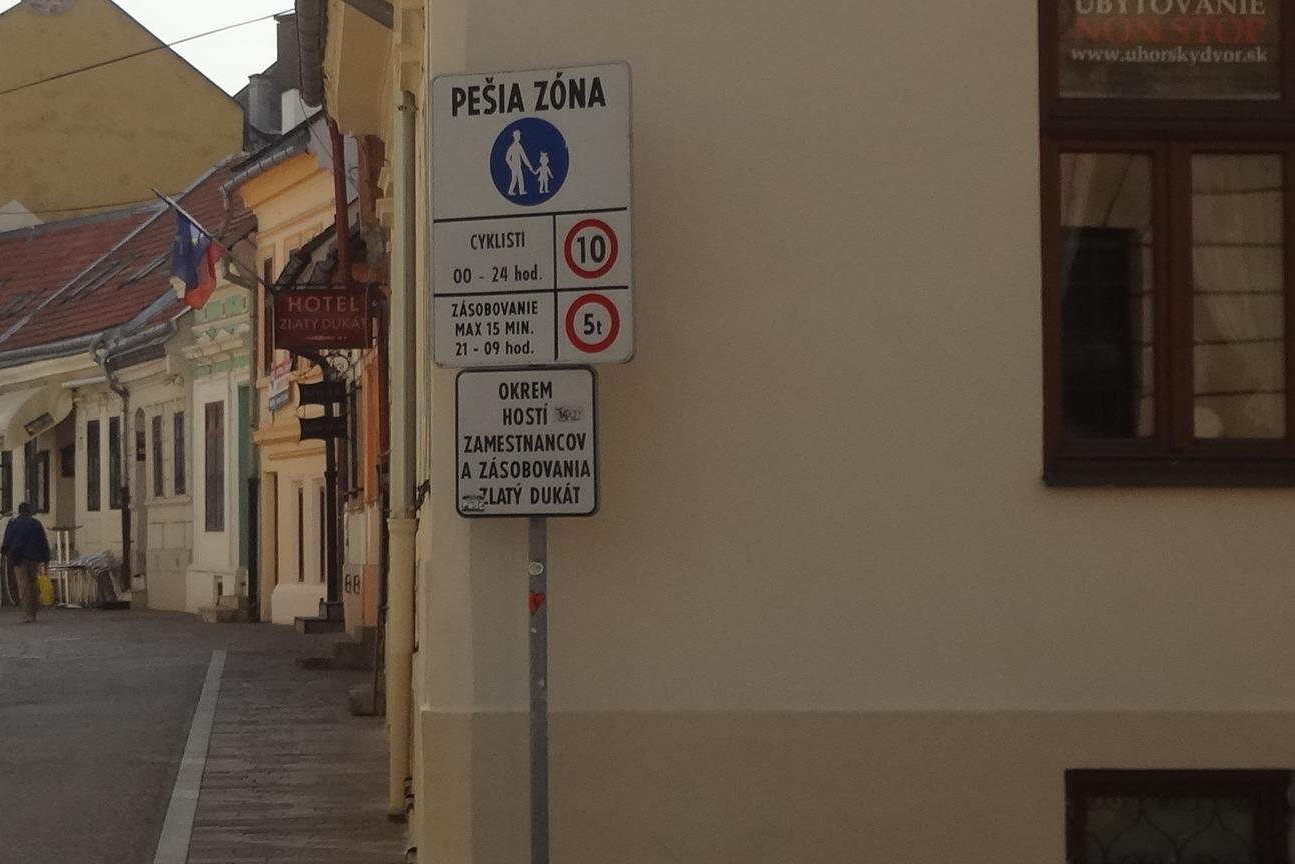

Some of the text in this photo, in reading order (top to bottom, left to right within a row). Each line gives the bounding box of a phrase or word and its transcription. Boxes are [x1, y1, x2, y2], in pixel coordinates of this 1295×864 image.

[1075, 16, 1267, 44] NON STOP
[1071, 45, 1269, 65] www.uhorskydvor.sk
[451, 72, 607, 117] PEŠIA ZÓNA
[470, 232, 526, 251] CYKLISTI
[576, 234, 606, 264] 10
[453, 268, 472, 284] 00
[492, 266, 509, 283] 24
[514, 264, 543, 282] hod.
[288, 295, 360, 313] HOTEL
[451, 300, 538, 318] ZÁSOBOVANIE
[455, 321, 535, 337] MAX 15 MIN.
[583, 313, 603, 336] 5t
[455, 341, 468, 356] 21
[484, 342, 500, 356] 09
[505, 339, 535, 356] hod.
[498, 381, 553, 400] OKREM
[502, 403, 548, 426] HOSTÍ
[463, 433, 587, 454] ZAMESTNANCOV
[461, 457, 591, 480] A ZÁSOBOVANIA
[479, 482, 523, 506] ZLATÝ
[530, 482, 581, 505] DUKÁT
